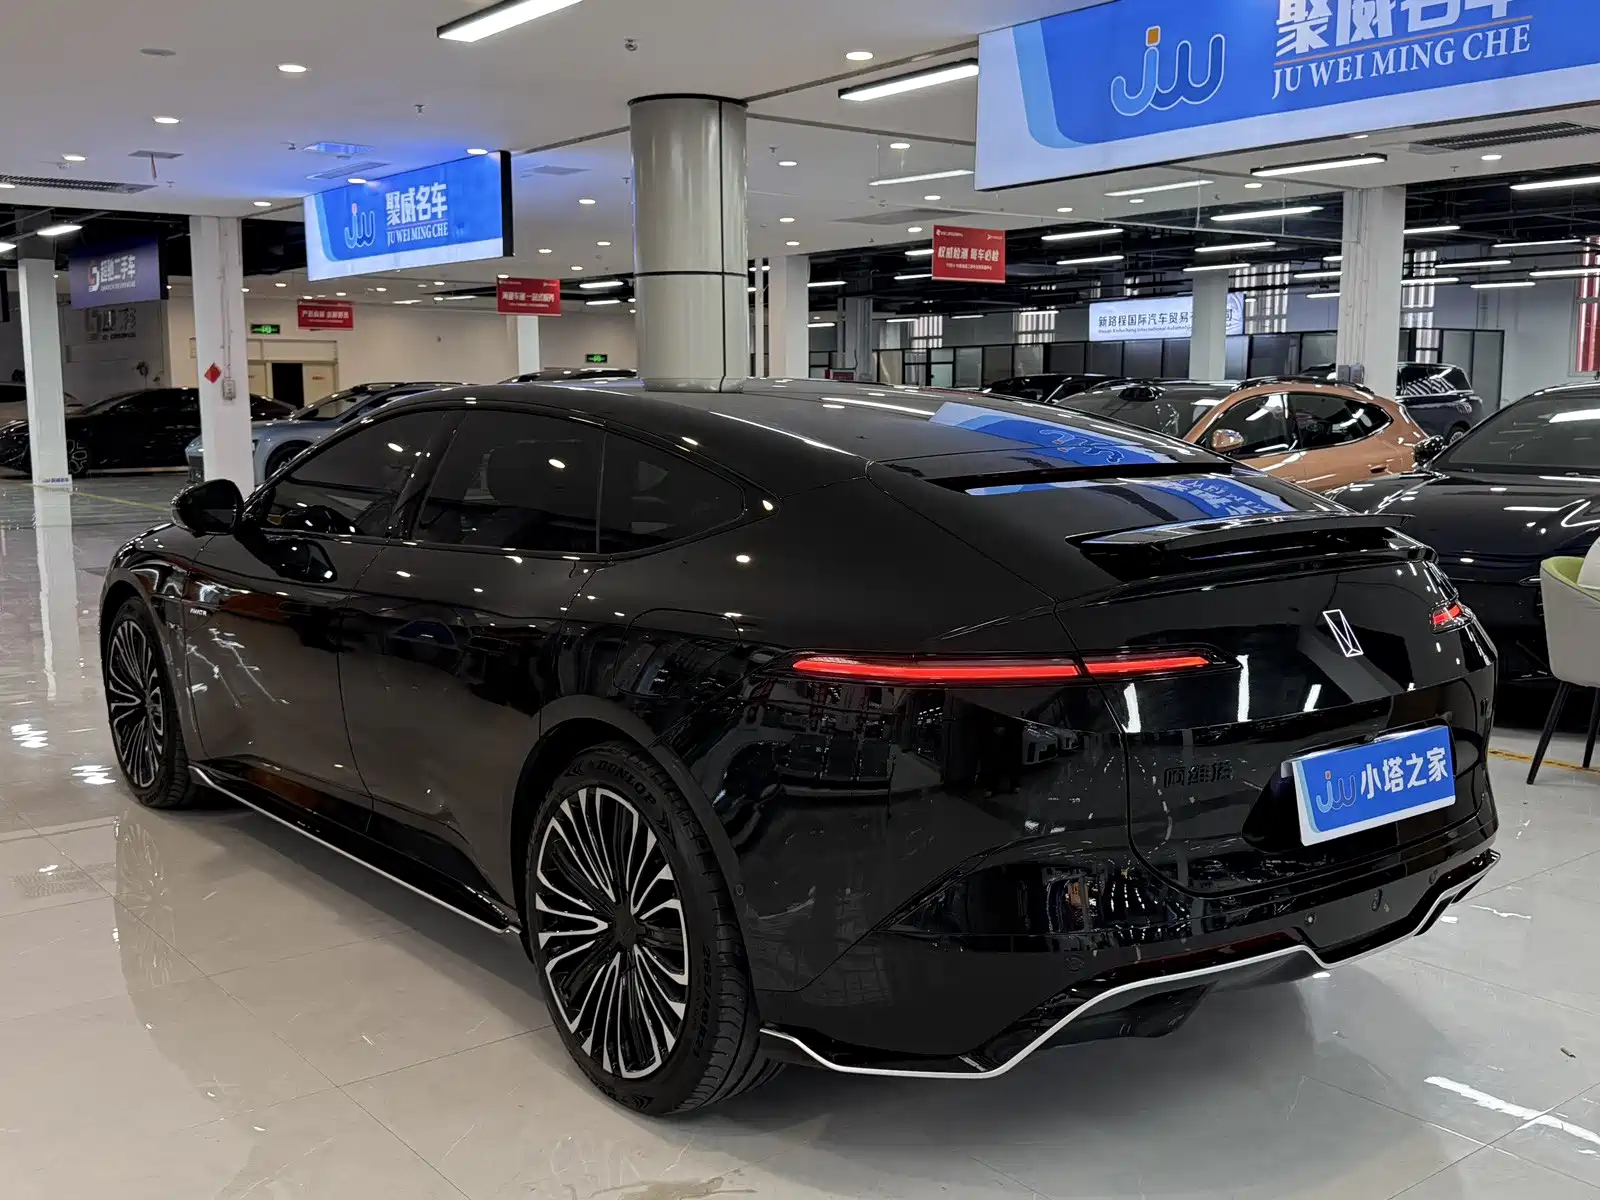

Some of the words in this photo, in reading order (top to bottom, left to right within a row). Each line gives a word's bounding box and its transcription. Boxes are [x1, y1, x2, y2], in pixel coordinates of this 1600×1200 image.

[1272, 65, 1302, 99] JU
[1310, 55, 1363, 87] WEI
[1370, 38, 1455, 78] MING
[1462, 23, 1531, 60] CHE
[385, 182, 448, 226] 聚威名车
[387, 231, 396, 247] JU
[396, 228, 411, 243] WEI
[411, 224, 432, 241] MING
[432, 222, 449, 238] CHE
[594, 758, 657, 805] DUNLOP
[1360, 747, 1449, 800] 小塔之家
